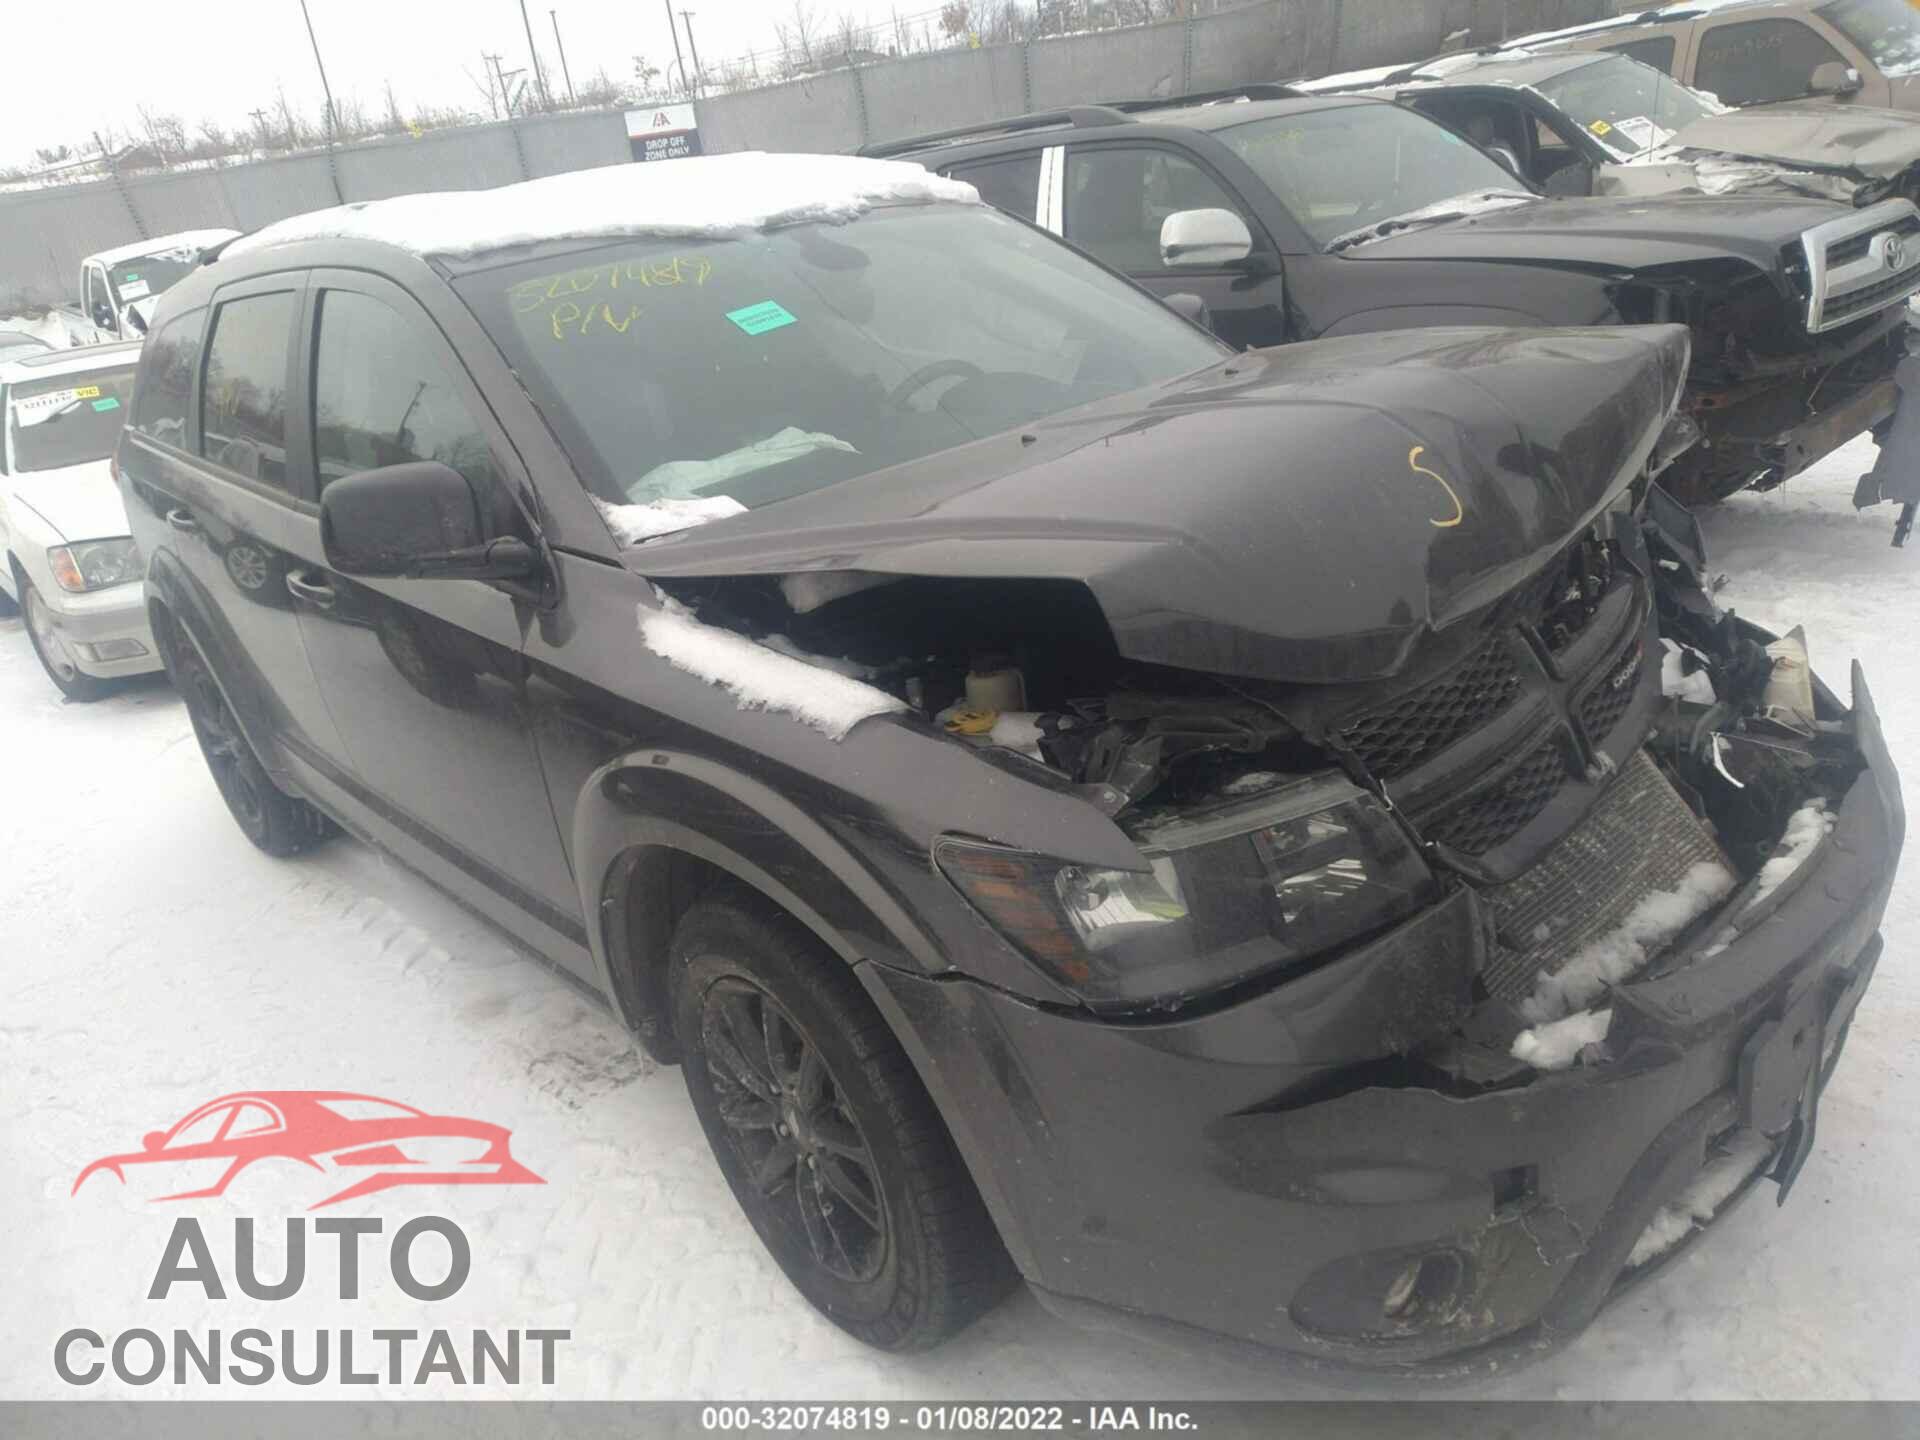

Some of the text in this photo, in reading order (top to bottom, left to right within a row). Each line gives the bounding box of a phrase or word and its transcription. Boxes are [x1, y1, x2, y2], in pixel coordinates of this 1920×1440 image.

[645, 135, 686, 150] DROP OFF
[645, 145, 690, 161] ZONE ONLY
